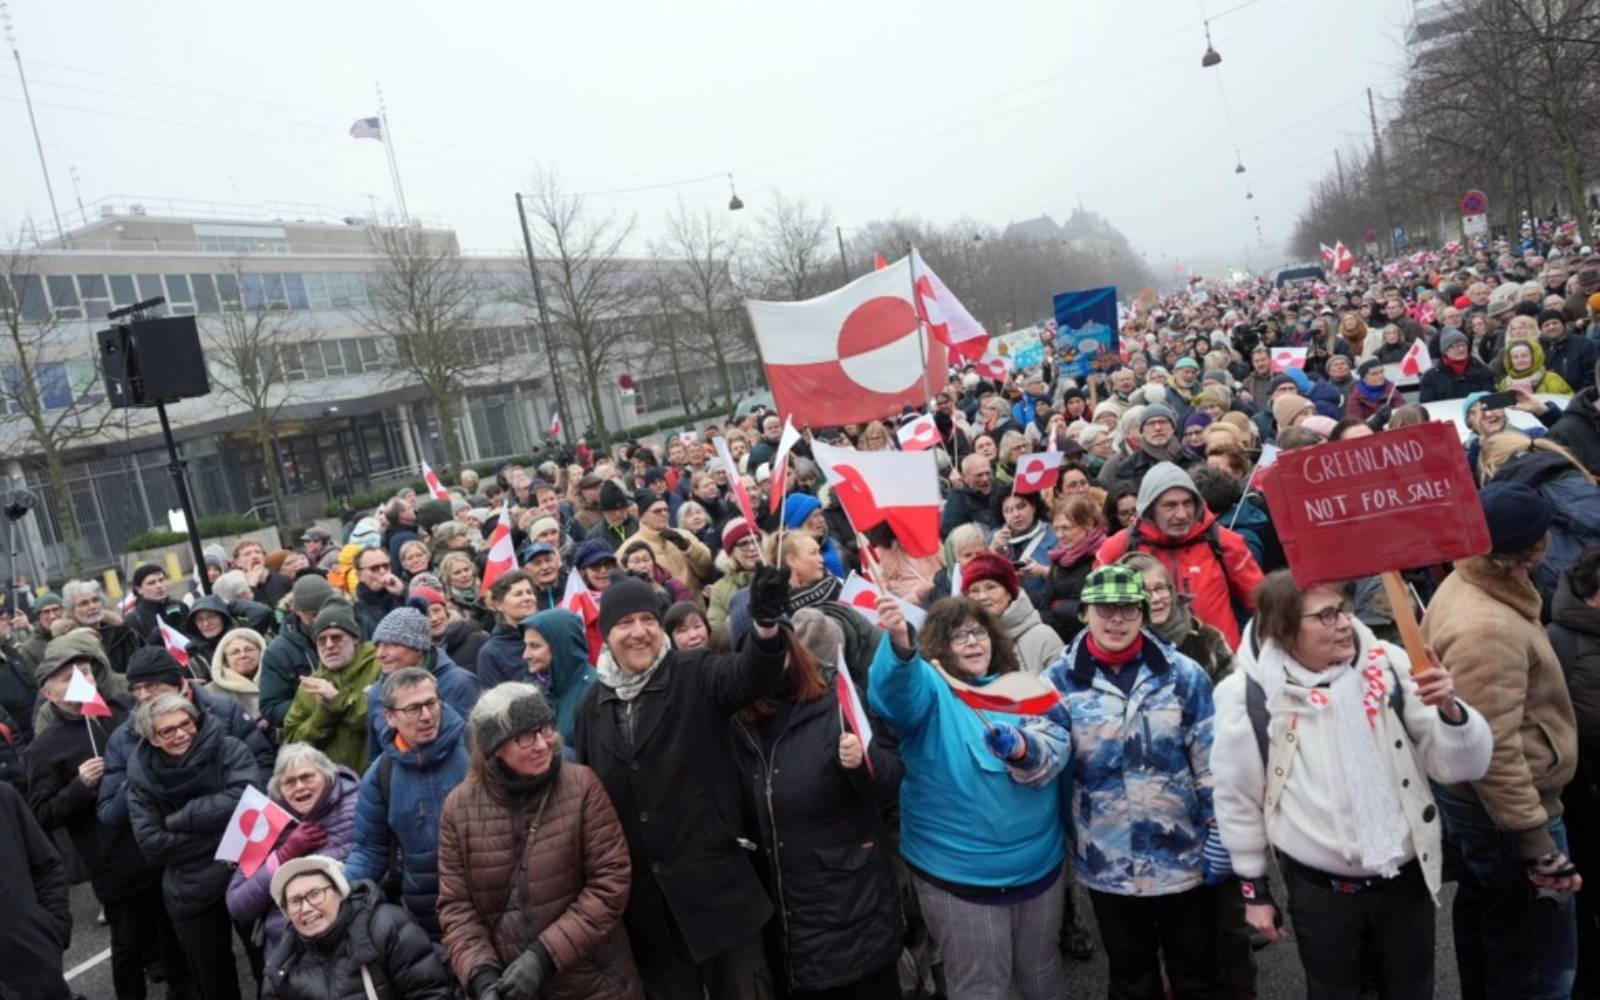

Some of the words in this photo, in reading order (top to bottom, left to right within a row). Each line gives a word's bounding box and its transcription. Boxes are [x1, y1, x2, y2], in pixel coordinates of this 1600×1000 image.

[1303, 440, 1423, 484] GREENLAND
[1304, 495, 1347, 522] NOT
[1361, 488, 1403, 511] FOR
[1407, 479, 1451, 503] SALE!
